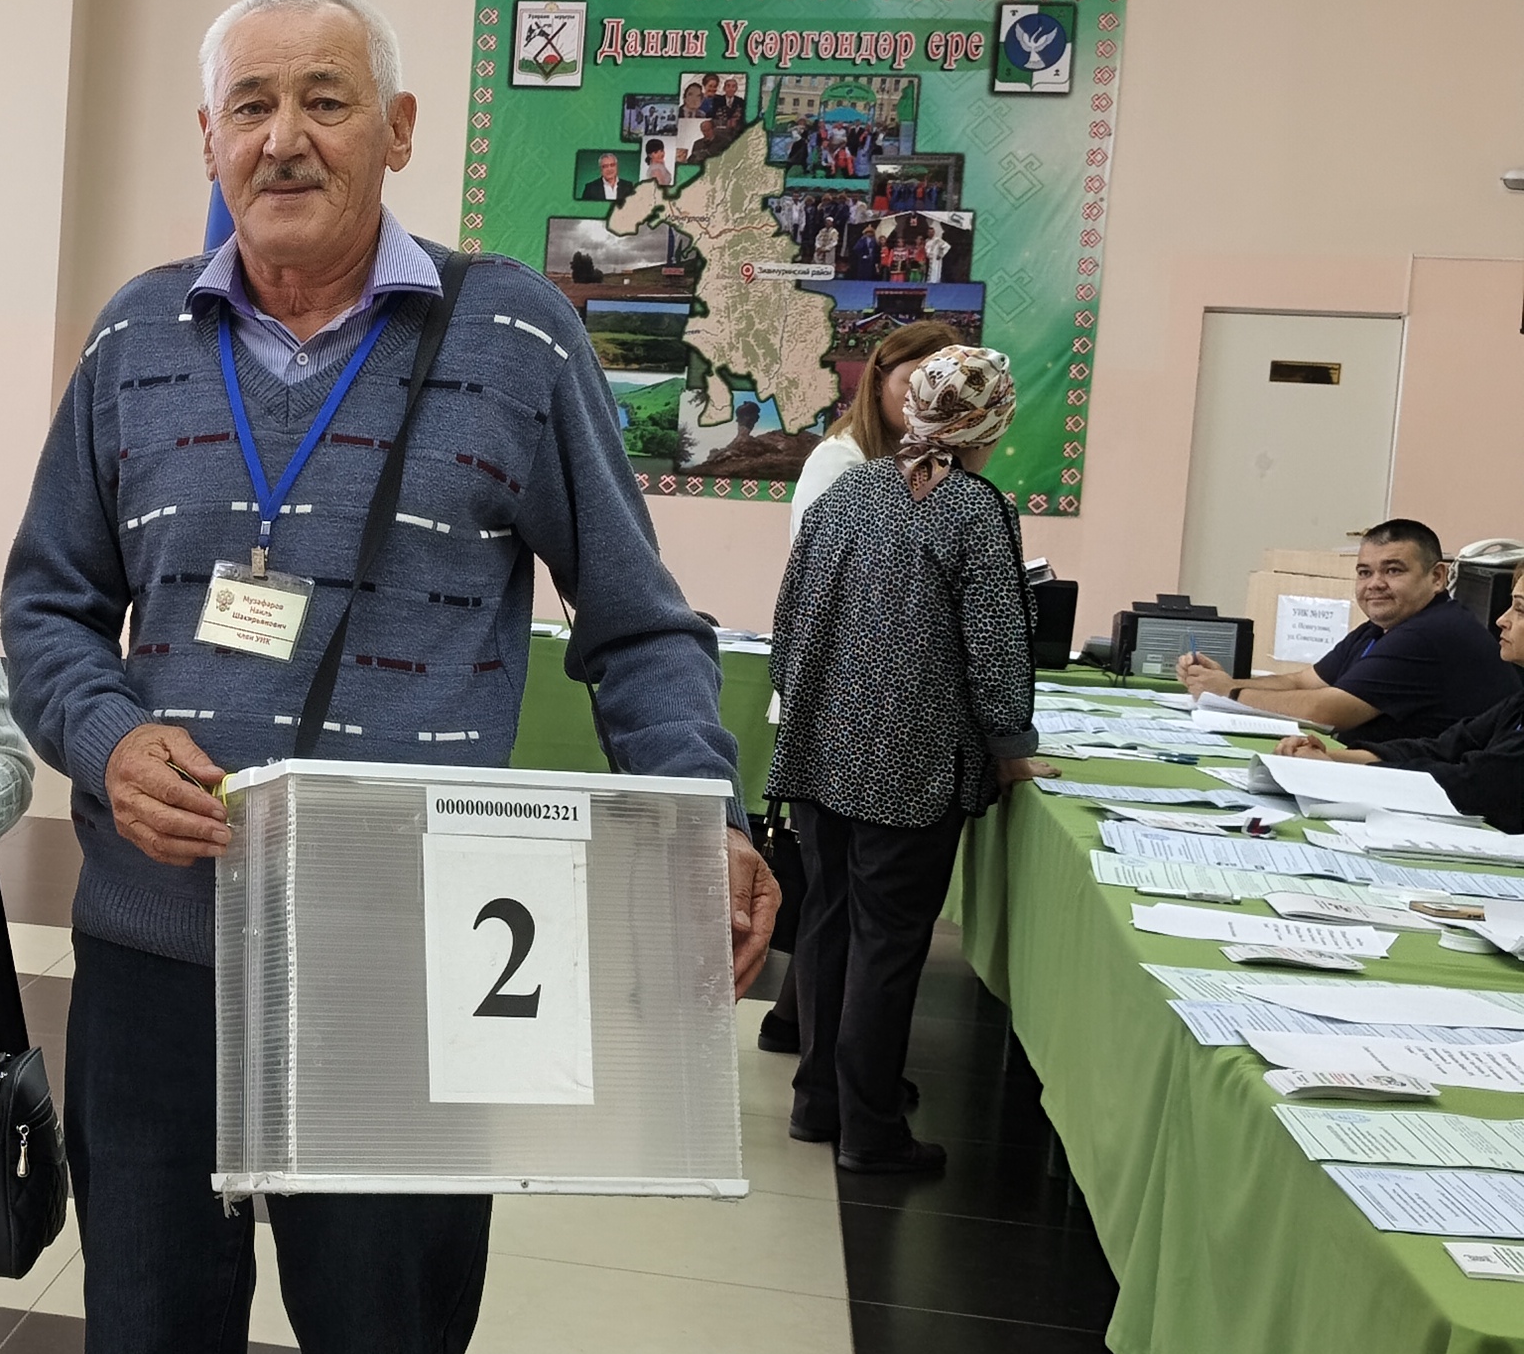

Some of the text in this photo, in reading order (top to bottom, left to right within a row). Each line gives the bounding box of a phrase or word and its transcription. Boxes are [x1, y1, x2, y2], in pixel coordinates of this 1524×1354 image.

[596, 18, 984, 69] Данлы Үҫәргәндәр ере
[436, 798, 579, 822] 000000000002321
[472, 897, 542, 1019] 2
